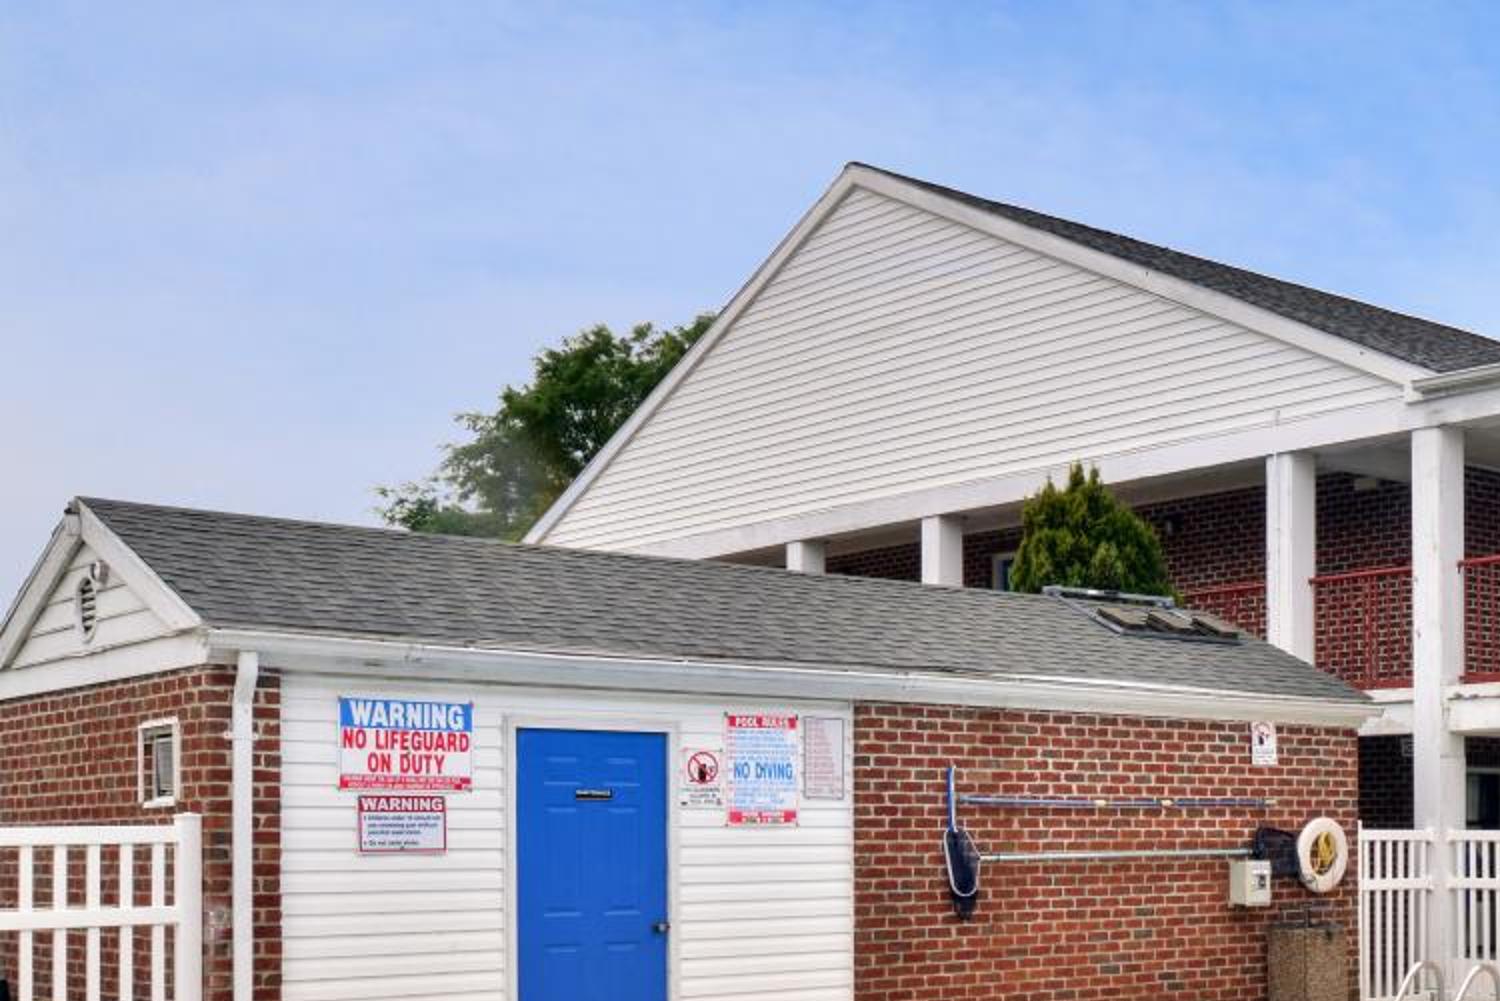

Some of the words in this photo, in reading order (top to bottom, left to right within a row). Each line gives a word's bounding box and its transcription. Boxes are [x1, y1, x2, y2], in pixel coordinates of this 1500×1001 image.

[350, 700, 465, 730] WARNING
[342, 728, 367, 749] NO
[375, 729, 469, 752] LIFEGUARD
[367, 751, 391, 773] ON
[400, 753, 445, 774] DUTY
[734, 762, 750, 780] NO
[755, 762, 793, 781] DIVING
[361, 797, 444, 811] WARNING
